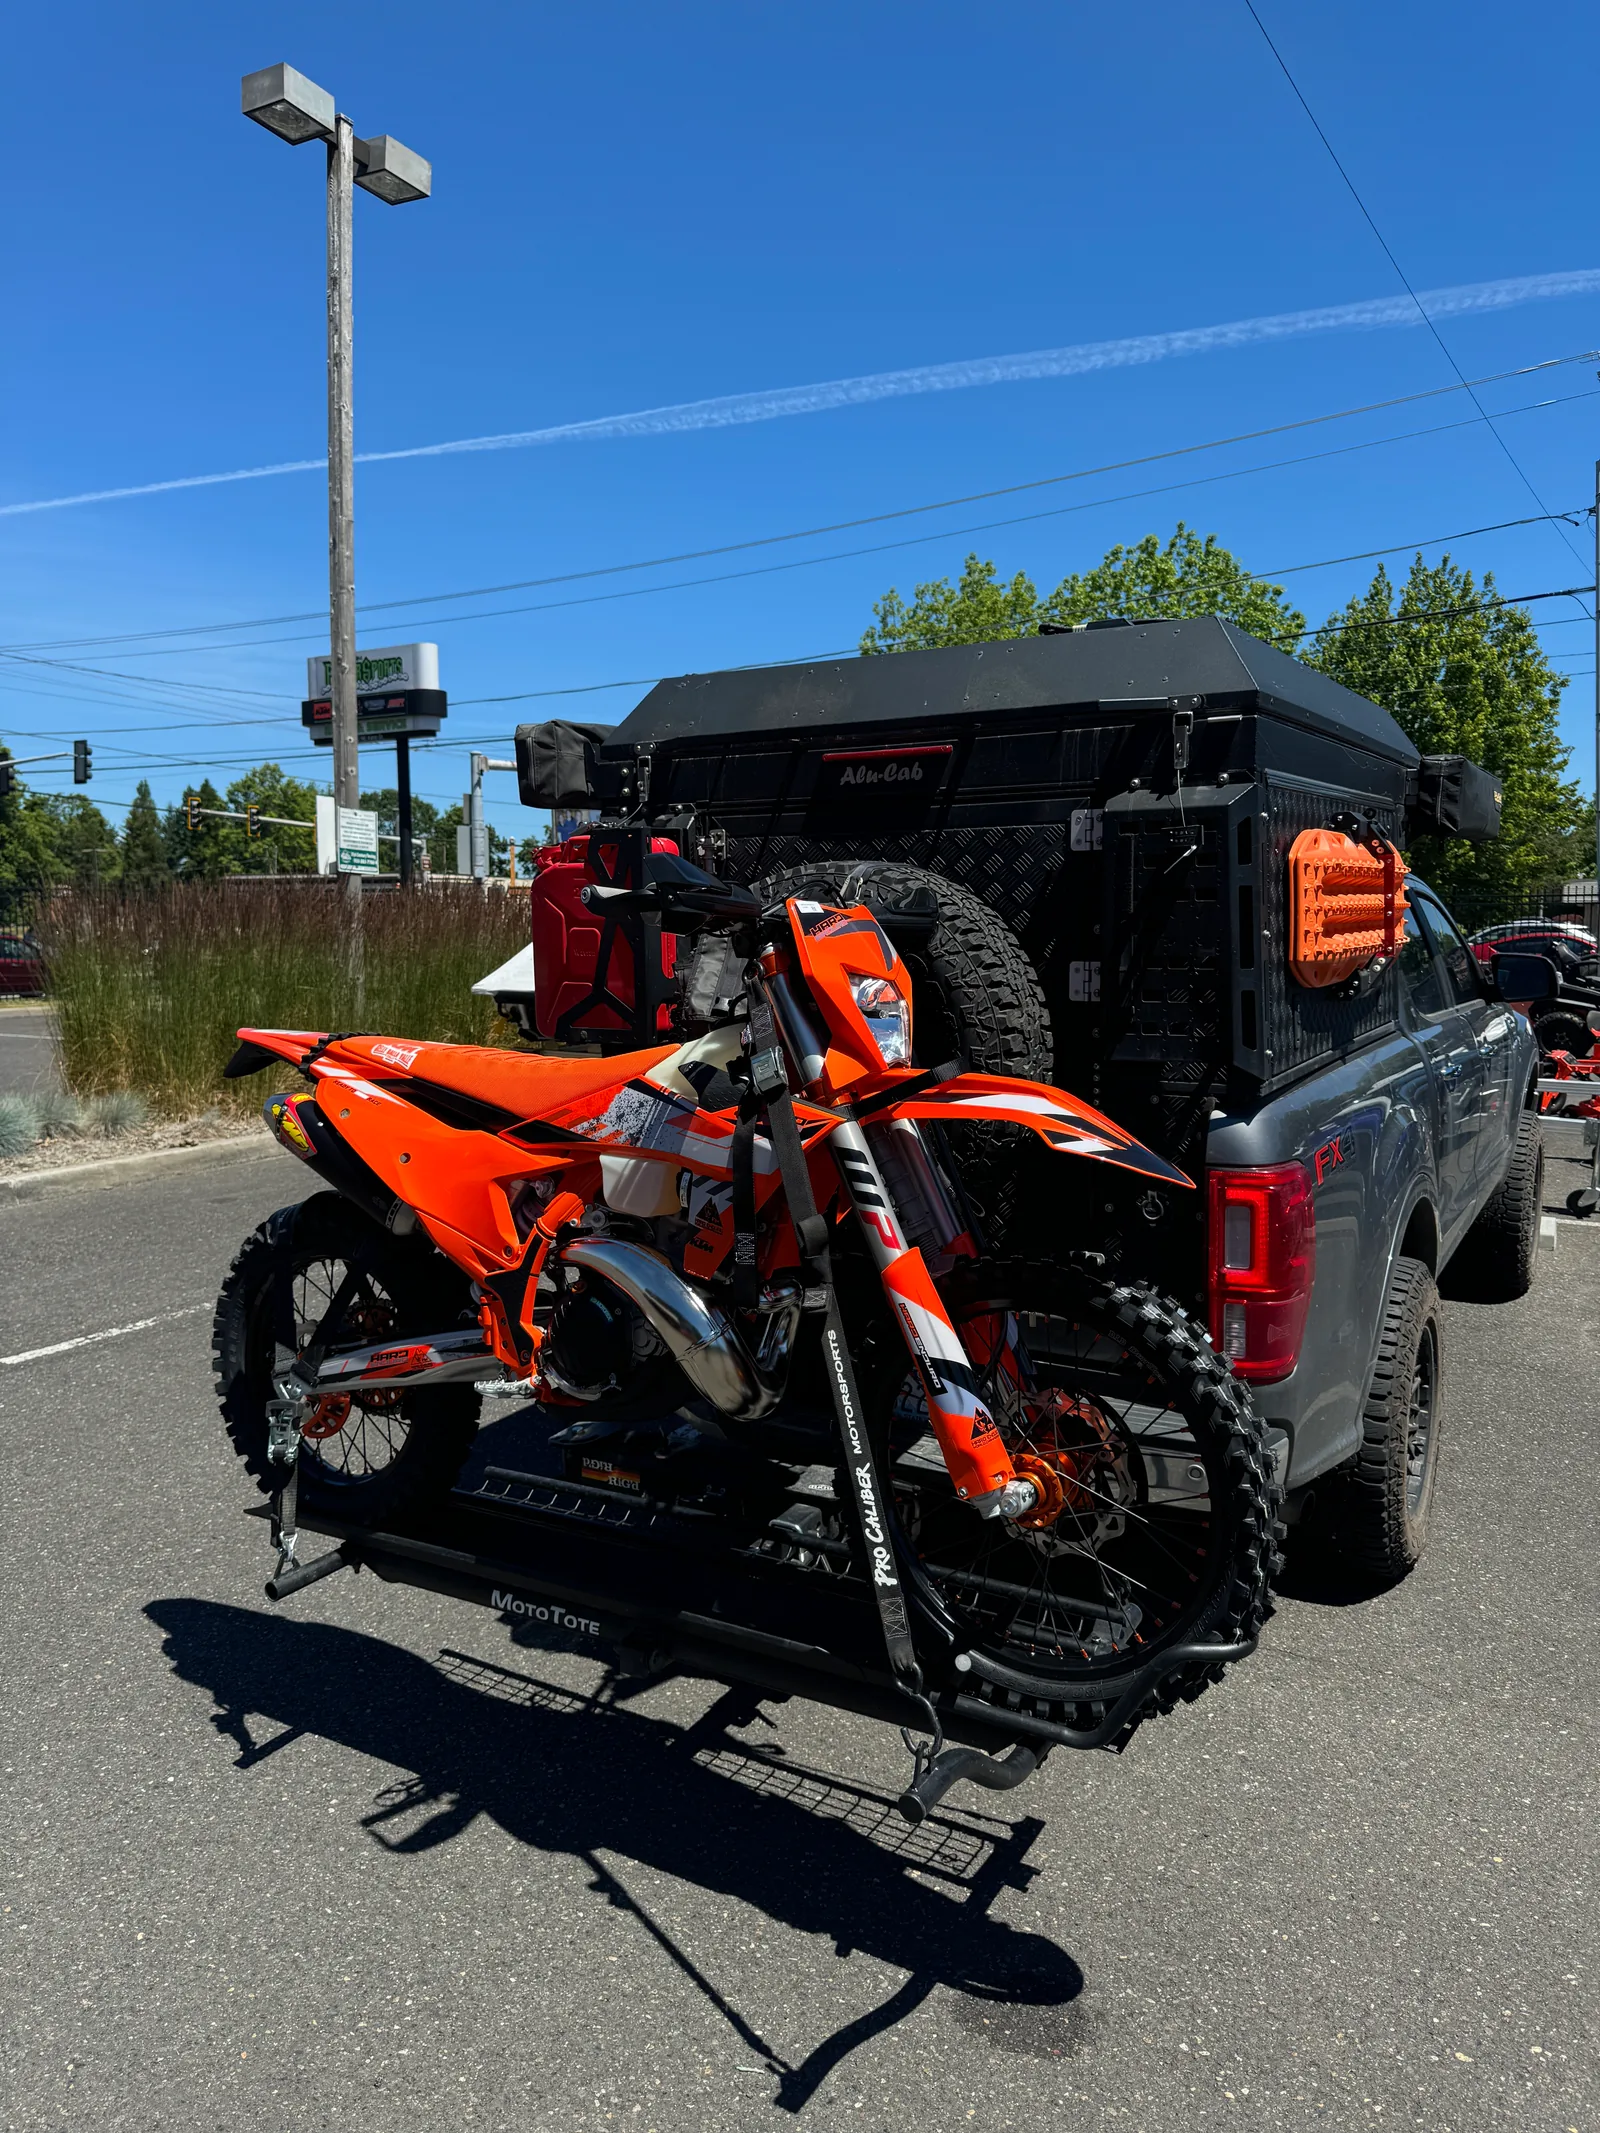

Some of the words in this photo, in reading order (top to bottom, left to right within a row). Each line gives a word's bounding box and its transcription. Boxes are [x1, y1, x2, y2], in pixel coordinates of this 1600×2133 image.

[840, 762, 923, 785] Alu-Cab
[828, 1329, 862, 1454] MOTORSPORTS
[855, 1462, 884, 1543] CALIBER
[873, 1547, 898, 1586] PRO
